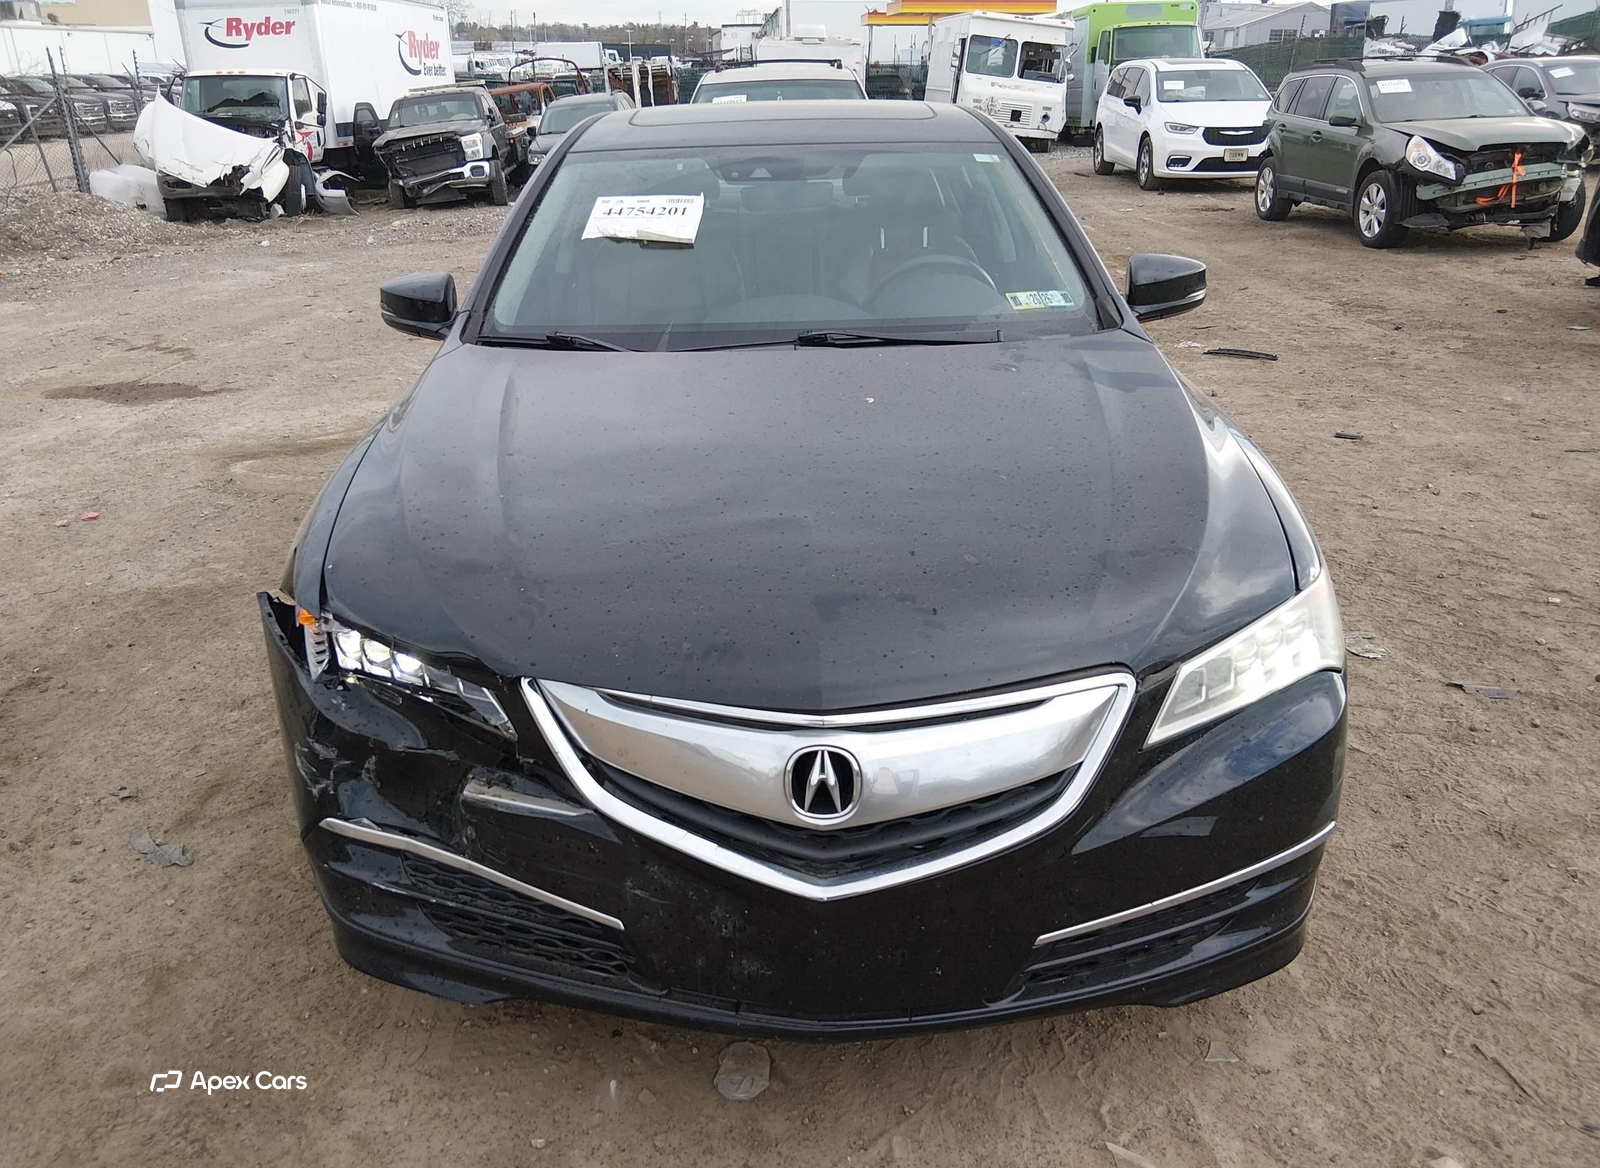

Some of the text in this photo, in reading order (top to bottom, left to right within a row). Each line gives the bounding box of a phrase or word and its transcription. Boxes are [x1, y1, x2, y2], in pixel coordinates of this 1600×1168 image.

[226, 16, 295, 41] Ryder
[407, 30, 440, 65] Ryder
[423, 62, 433, 76] Ever
[603, 206, 687, 216] 44754201
